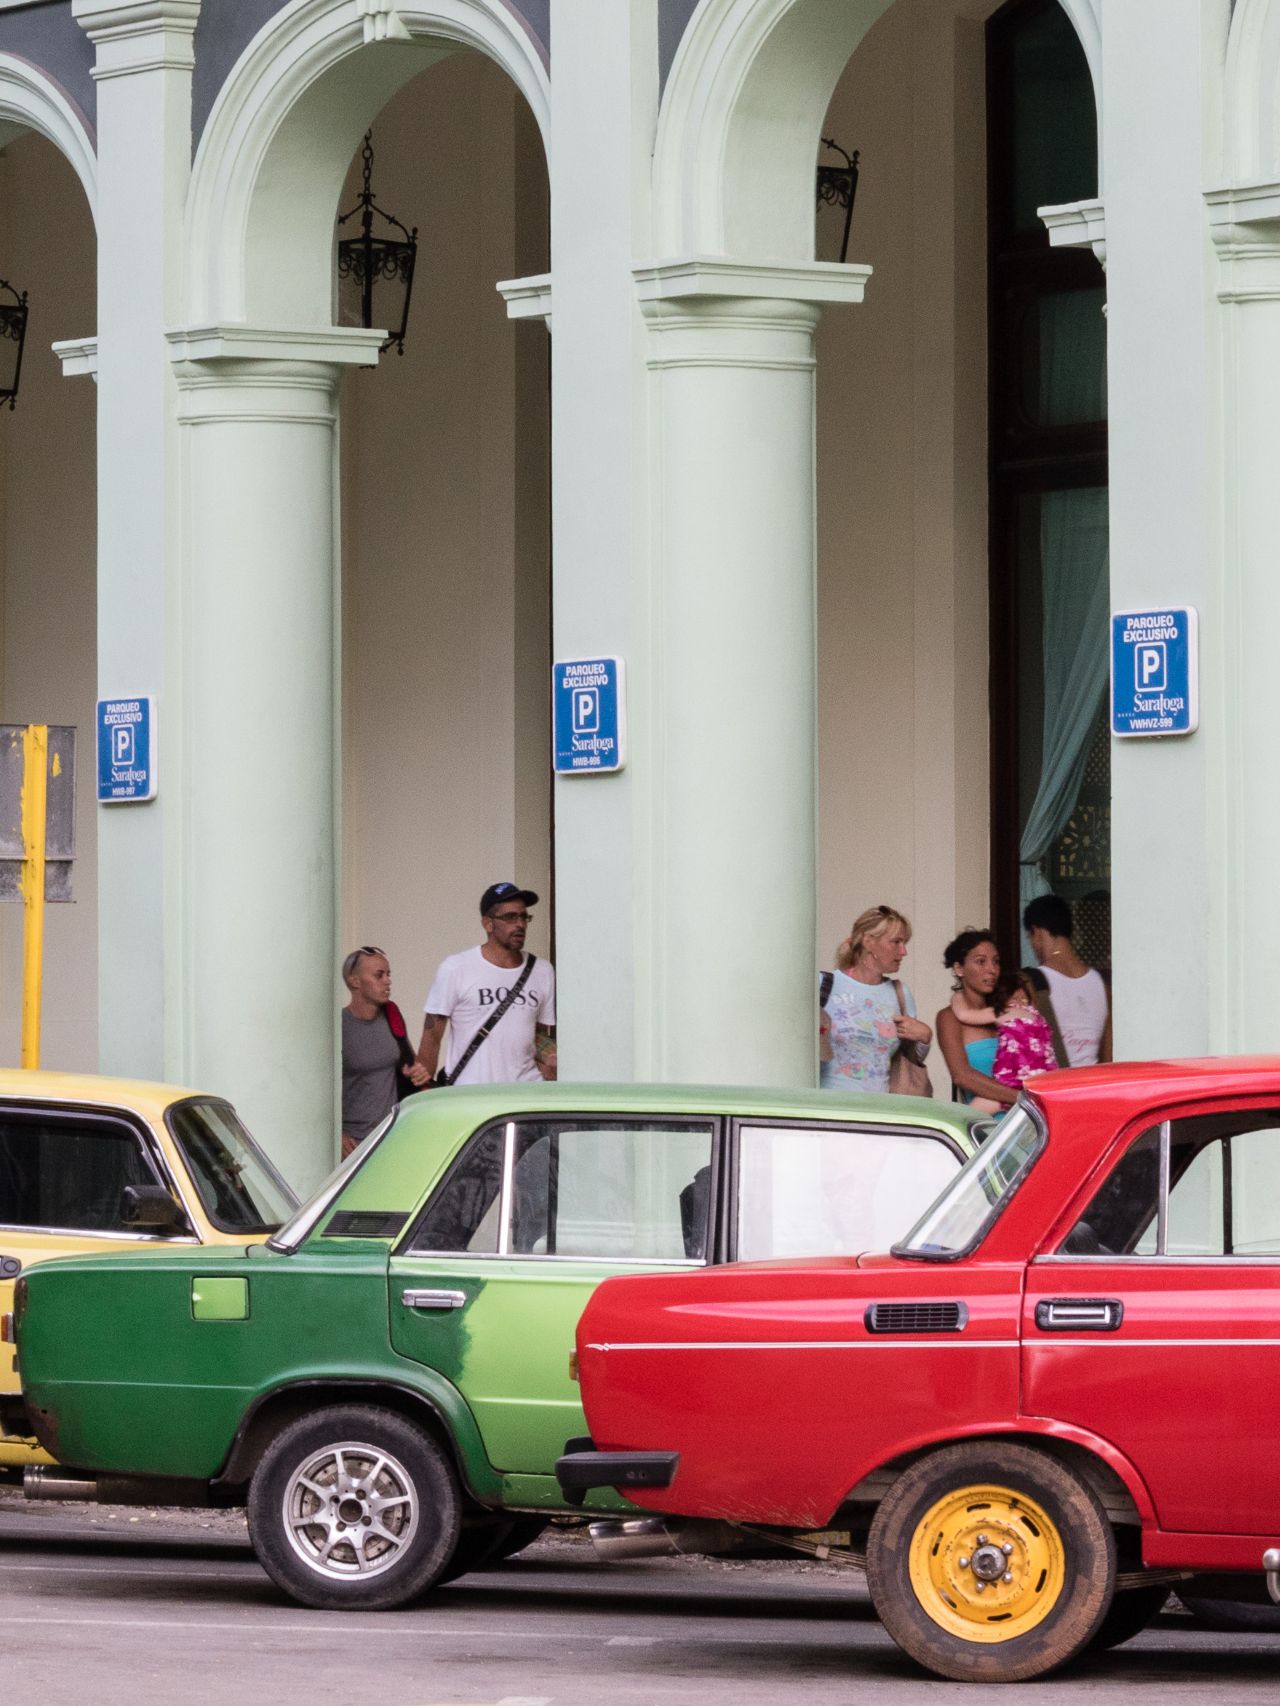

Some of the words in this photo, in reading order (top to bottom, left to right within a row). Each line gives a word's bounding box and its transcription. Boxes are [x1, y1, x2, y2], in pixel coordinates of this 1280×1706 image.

[1126, 615, 1174, 629] PARQUEO
[1123, 628, 1178, 643] EXCLUSIVO
[565, 663, 605, 676] PARQUEO
[1142, 650, 1160, 684] P
[562, 675, 609, 688] EXCLUSIVO
[106, 702, 140, 714] PARQUEO
[579, 694, 594, 726] P
[1133, 693, 1184, 717] Saratoga
[104, 713, 143, 725] EXCLUSIVO
[117, 730, 130, 759] P
[571, 733, 614, 755] Saratoga
[111, 766, 147, 786] Saratoga
[478, 986, 539, 1008] BOSS
